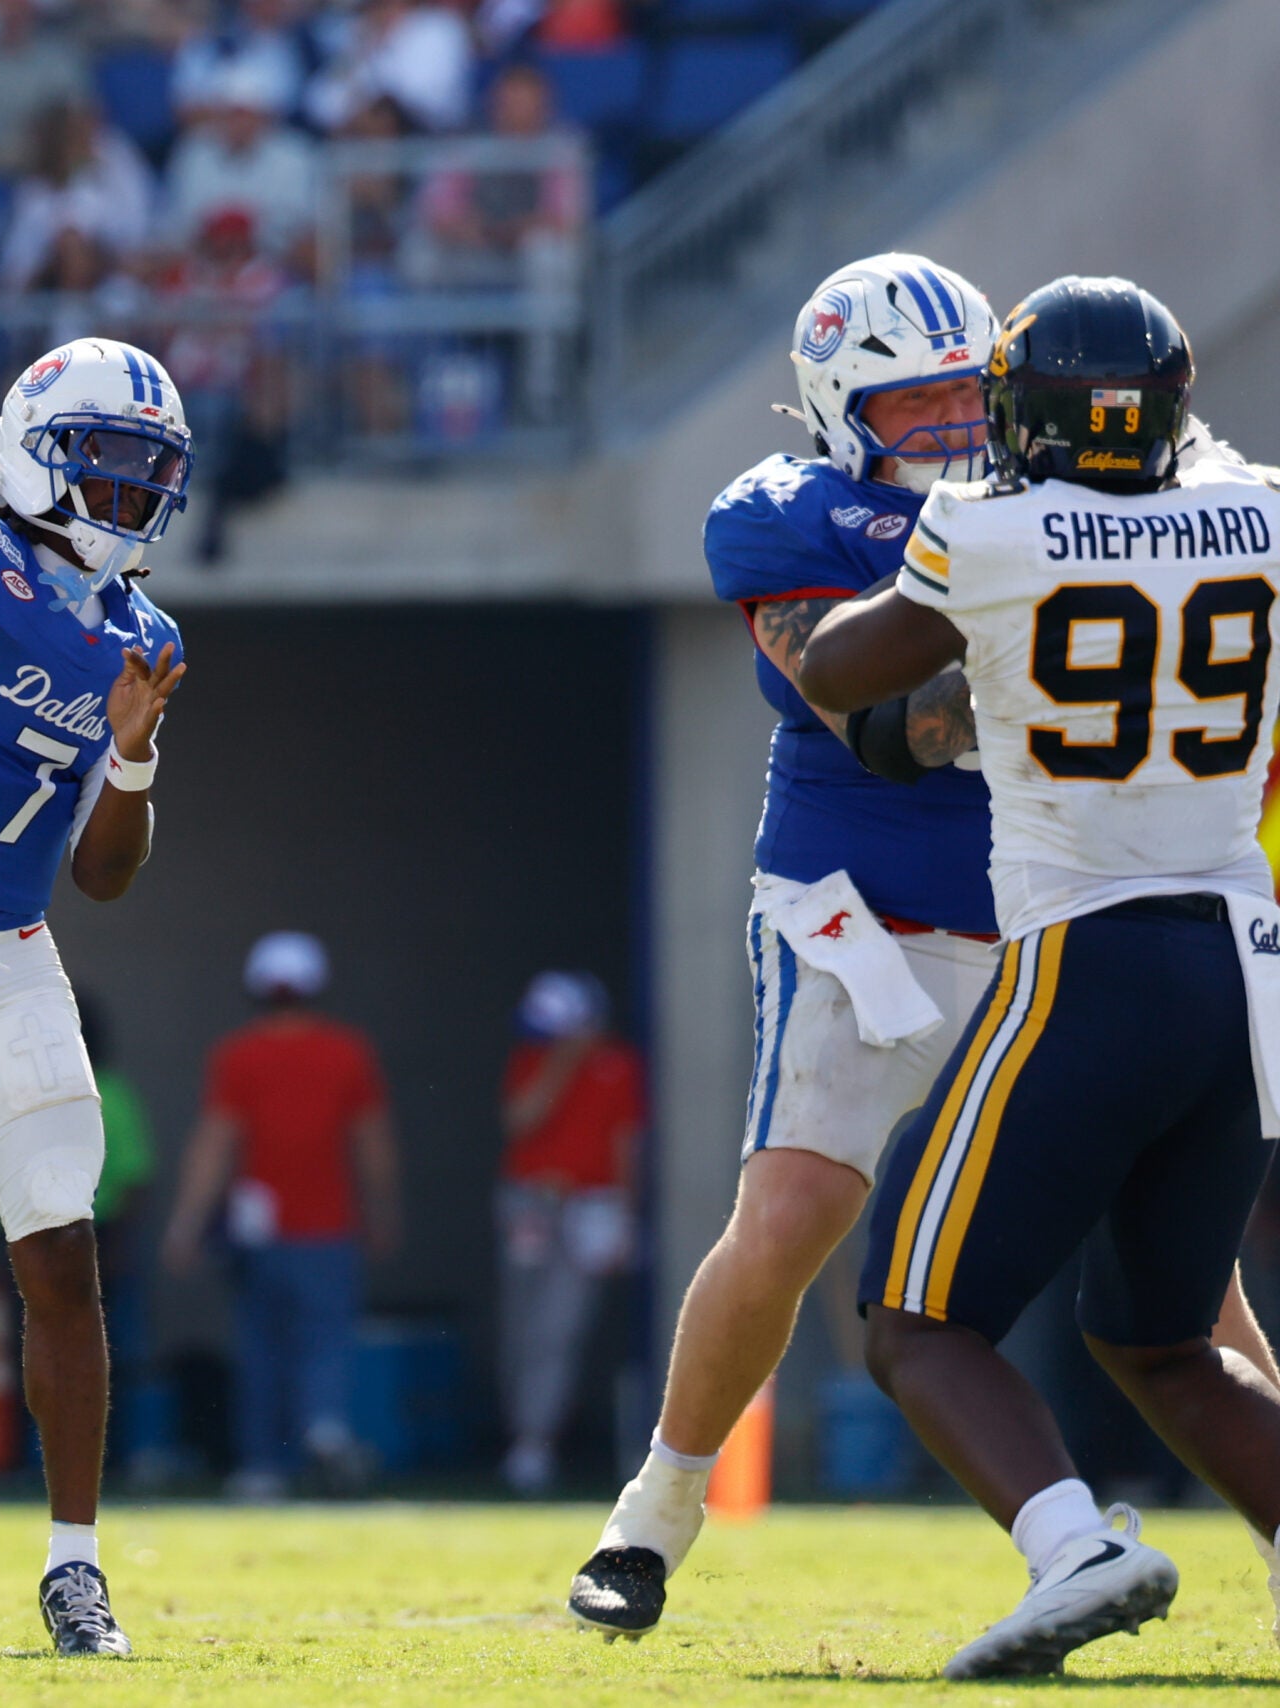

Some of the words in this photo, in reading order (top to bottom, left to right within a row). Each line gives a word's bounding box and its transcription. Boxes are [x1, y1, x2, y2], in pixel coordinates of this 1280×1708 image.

[1076, 450, 1141, 471] California
[872, 516, 902, 535] ACC
[1042, 505, 1271, 562] SHEPPHARD
[4, 575, 31, 597] ACC
[1026, 573, 1279, 784] 99
[1249, 917, 1280, 956] Cal
